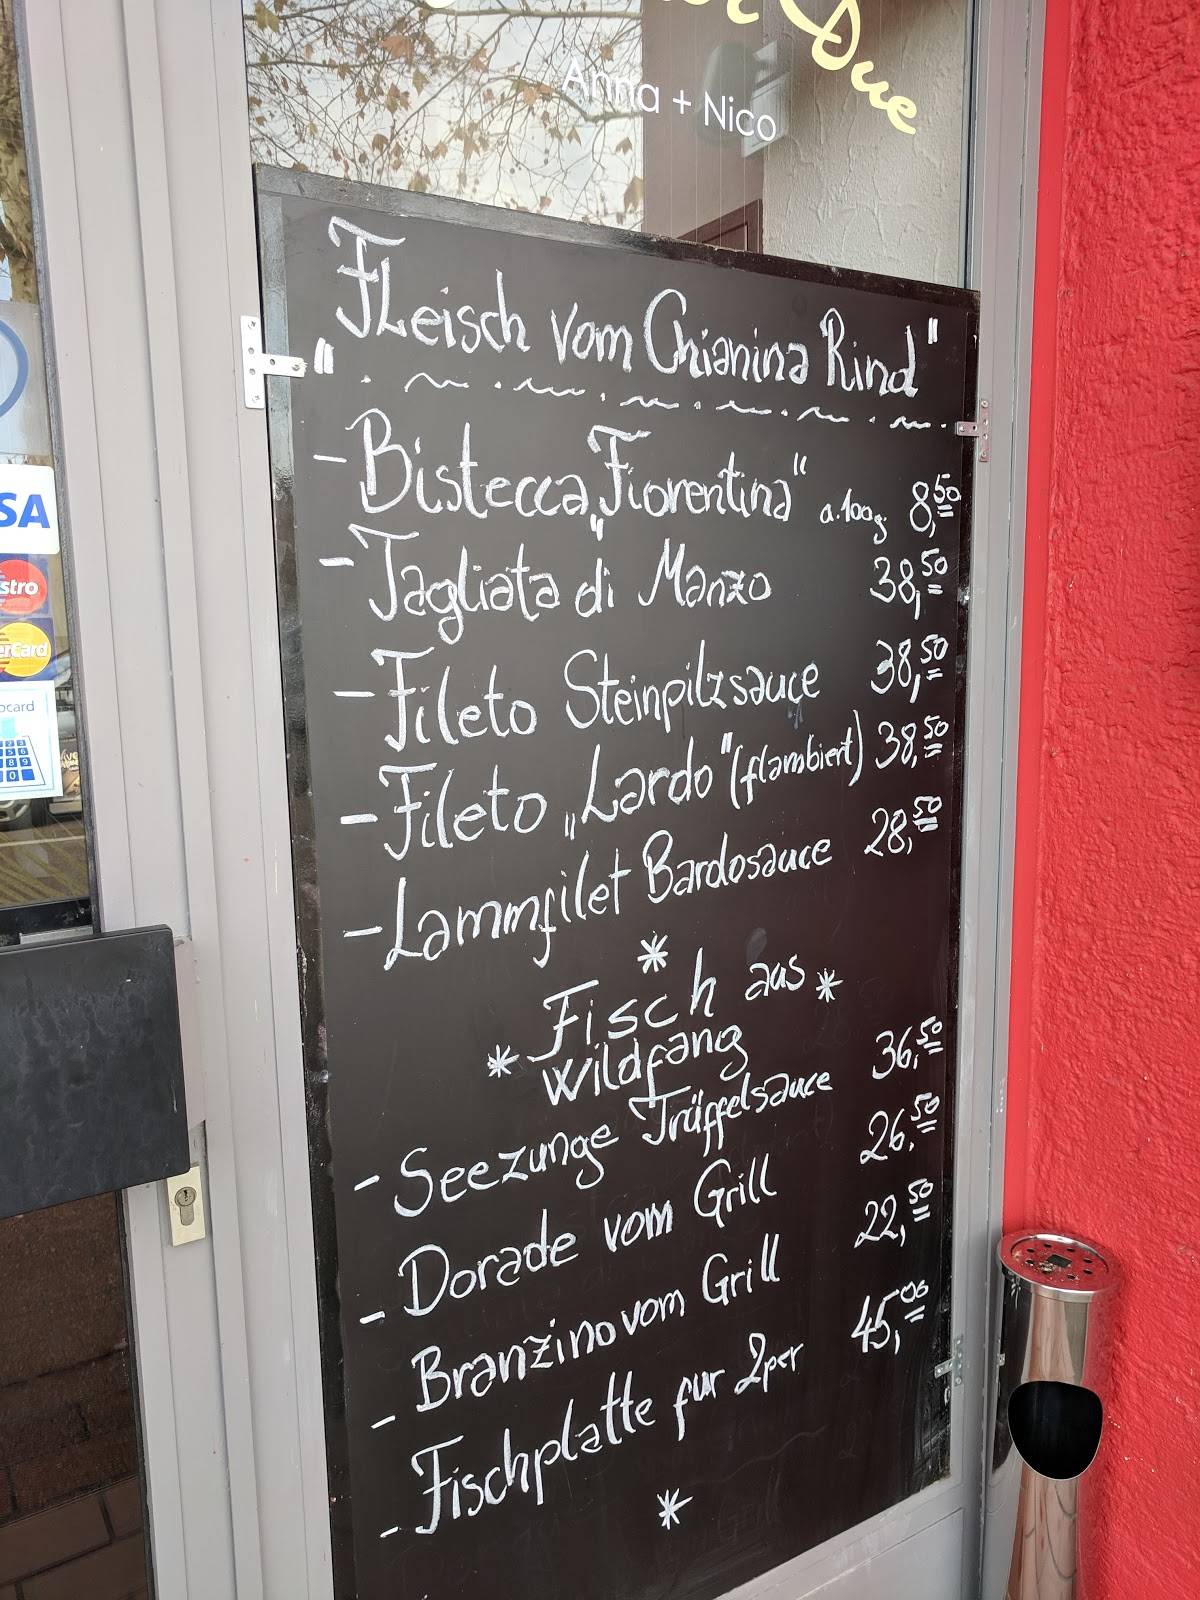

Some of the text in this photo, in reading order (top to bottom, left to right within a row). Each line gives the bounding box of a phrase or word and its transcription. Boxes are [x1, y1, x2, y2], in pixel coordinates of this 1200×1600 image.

[561, 57, 660, 114] Anna
[704, 91, 776, 142] Nico
[643, 288, 808, 385] Chianina
[345, 408, 588, 518] Bistecca
[348, 523, 560, 644] Tagliata
[574, 557, 615, 618] di
[638, 537, 772, 609] Manzo
[370, 646, 538, 752] Fileto
[564, 639, 821, 734] Steinpilzsauce
[378, 762, 548, 861] Fileto
[730, 709, 864, 809] (flambiert)
[383, 848, 632, 970] Lammfilet
[642, 829, 833, 904] Bardosauce
[526, 946, 806, 1063] Fisch aus
[393, 1123, 620, 1218] Seezunge
[628, 1071, 834, 1158] Trüffelsauce
[397, 1208, 580, 1317] Dorade
[603, 1199, 674, 1253] vom
[693, 1152, 778, 1229] Grill
[411, 1318, 617, 1413] Branzino
[620, 1289, 686, 1336] vom
[701, 1233, 781, 1306] Grill
[410, 1370, 656, 1535] Fischplatte
